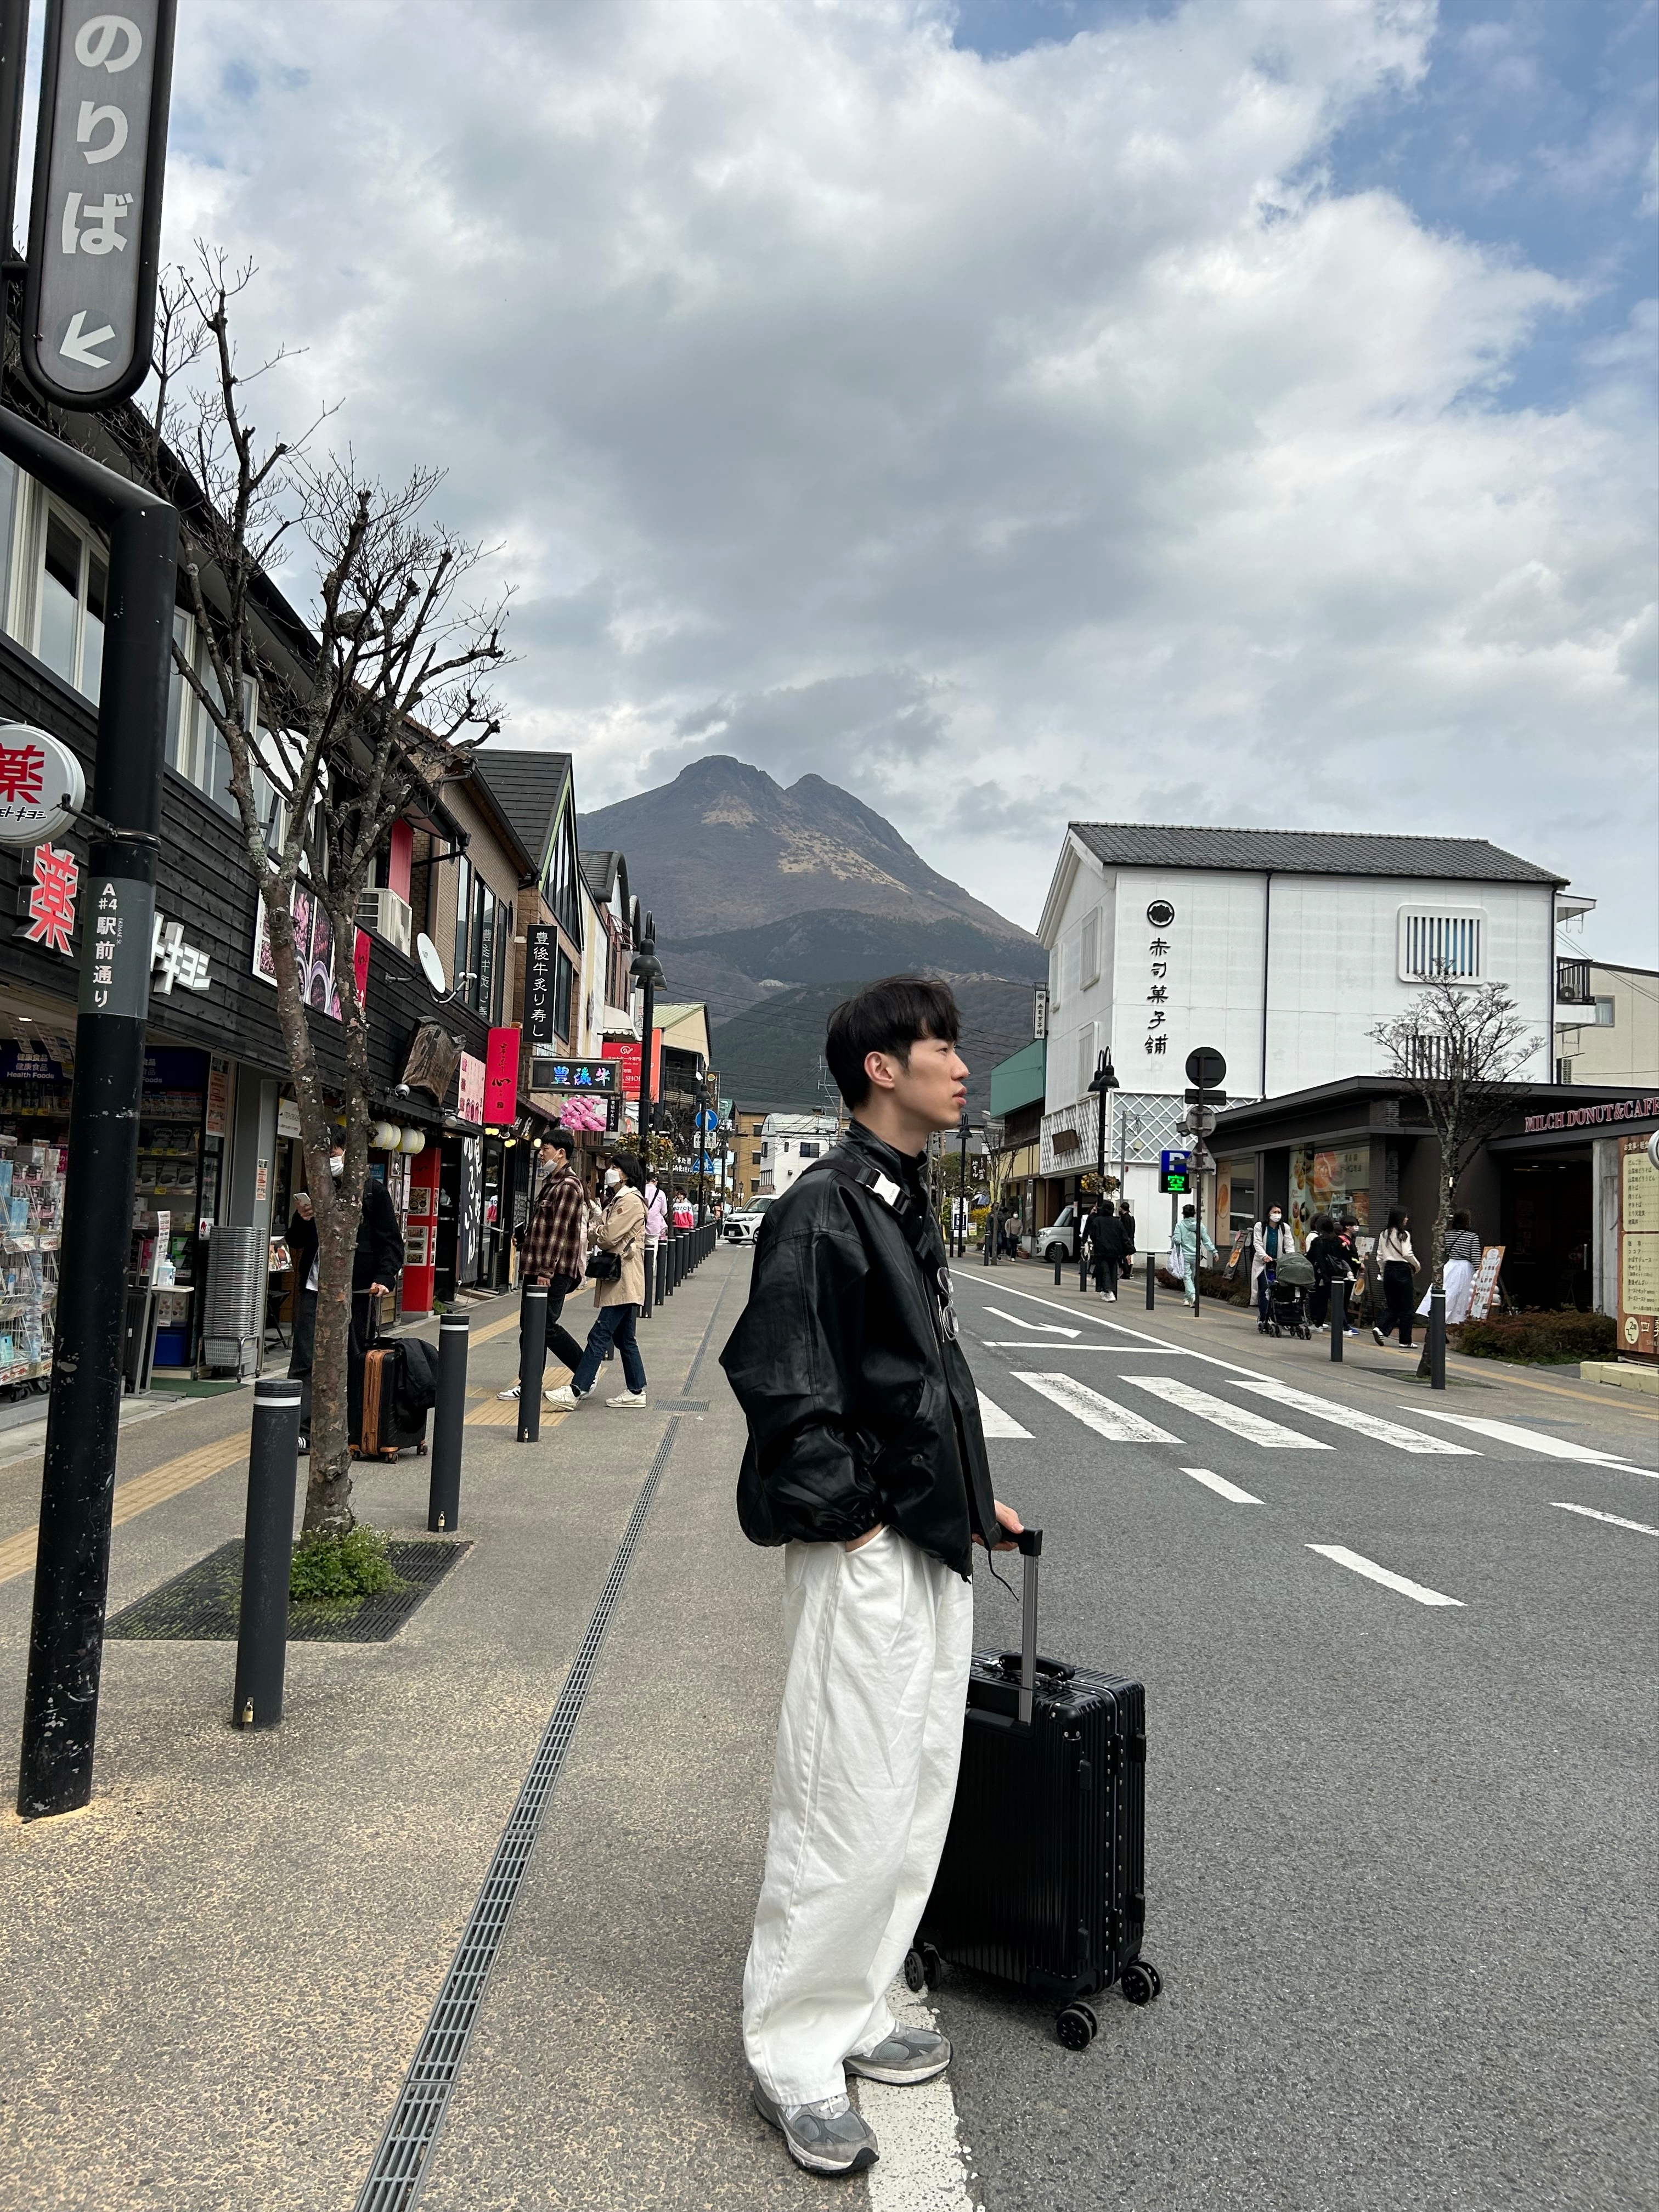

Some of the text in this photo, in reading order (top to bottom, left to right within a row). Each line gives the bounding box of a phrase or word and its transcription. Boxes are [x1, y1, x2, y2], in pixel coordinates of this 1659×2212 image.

[63, 14, 142, 256] のりば
[0, 743, 45, 804] 薬
[29, 843, 78, 957] 薬
[102, 883, 116, 896] A
[99, 898, 117, 910] #4
[93, 916, 116, 1008] 駅前通り
[531, 932, 550, 1037] 豊後牛炙り寿し
[1144, 938, 1171, 1054] 赤司菓子舗
[17, 1053, 48, 1062] 健康食品
[551, 1065, 611, 1086] 豊後牛
[1525, 1111, 1565, 1132] MILCH
[1169, 1153, 1185, 1171] P
[1167, 1175, 1184, 1191] 空
